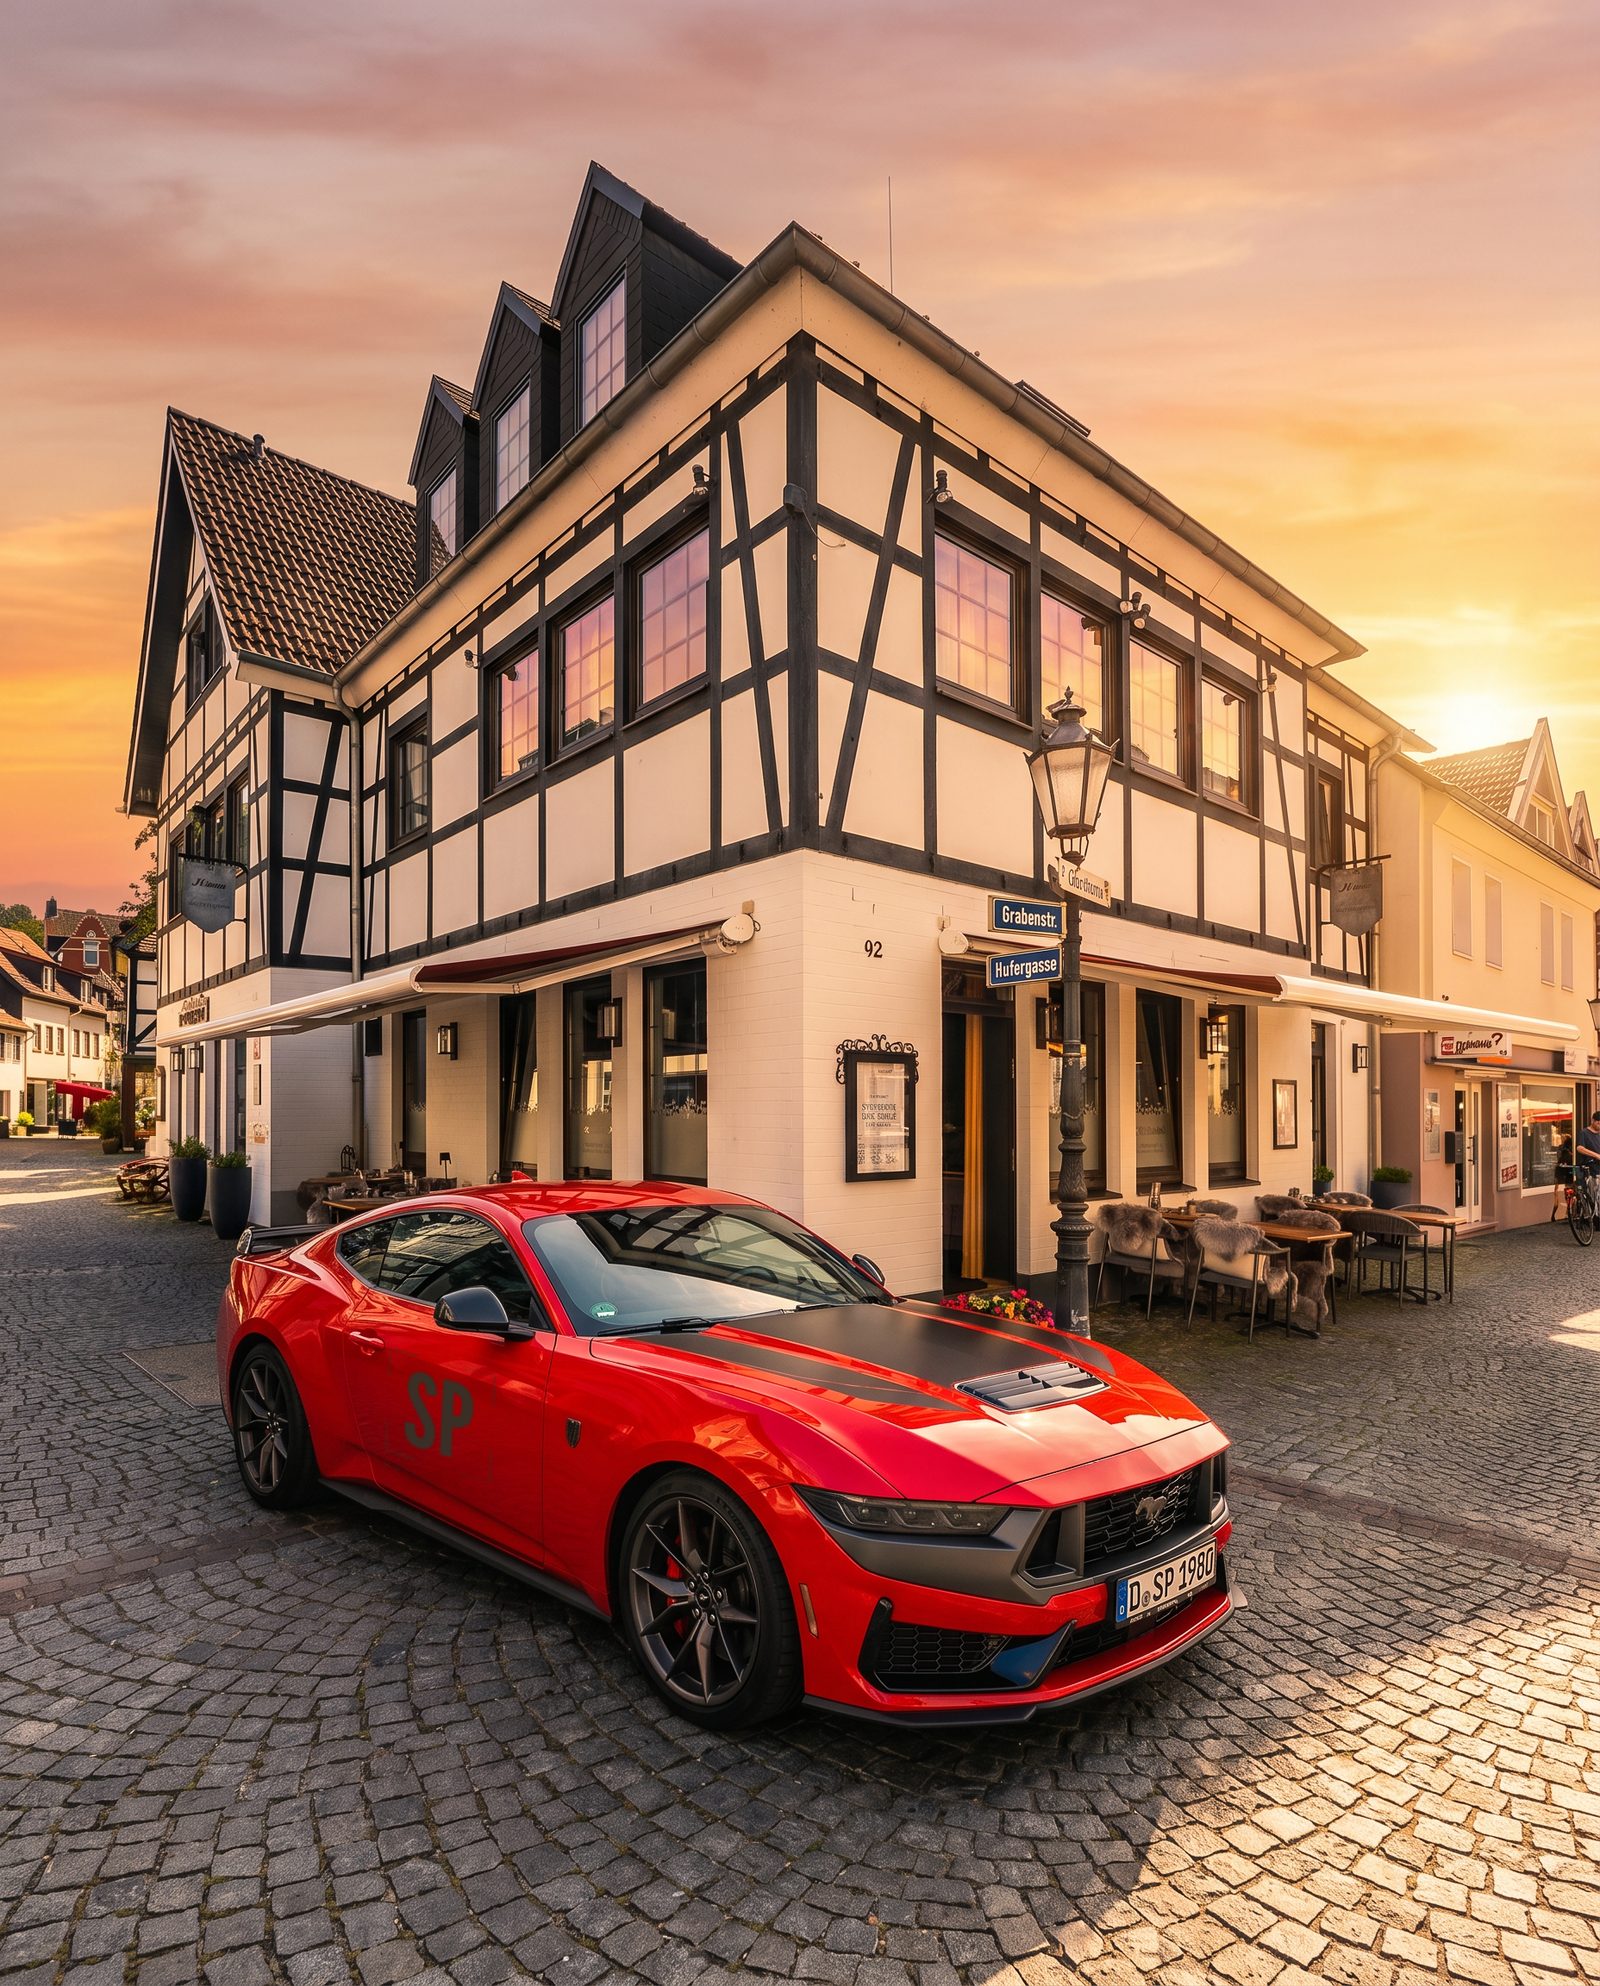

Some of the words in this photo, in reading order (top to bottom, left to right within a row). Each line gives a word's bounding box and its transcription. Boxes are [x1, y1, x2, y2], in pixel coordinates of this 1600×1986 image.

[1002, 905, 1057, 928] Grabenstr.
[864, 939, 883, 958] 92
[995, 958, 1057, 979] Hufergasse
[404, 1371, 475, 1457] SP
[1129, 1581, 1140, 1612] D
[1152, 1567, 1174, 1601] SP
[1178, 1547, 1214, 1590] 1980
